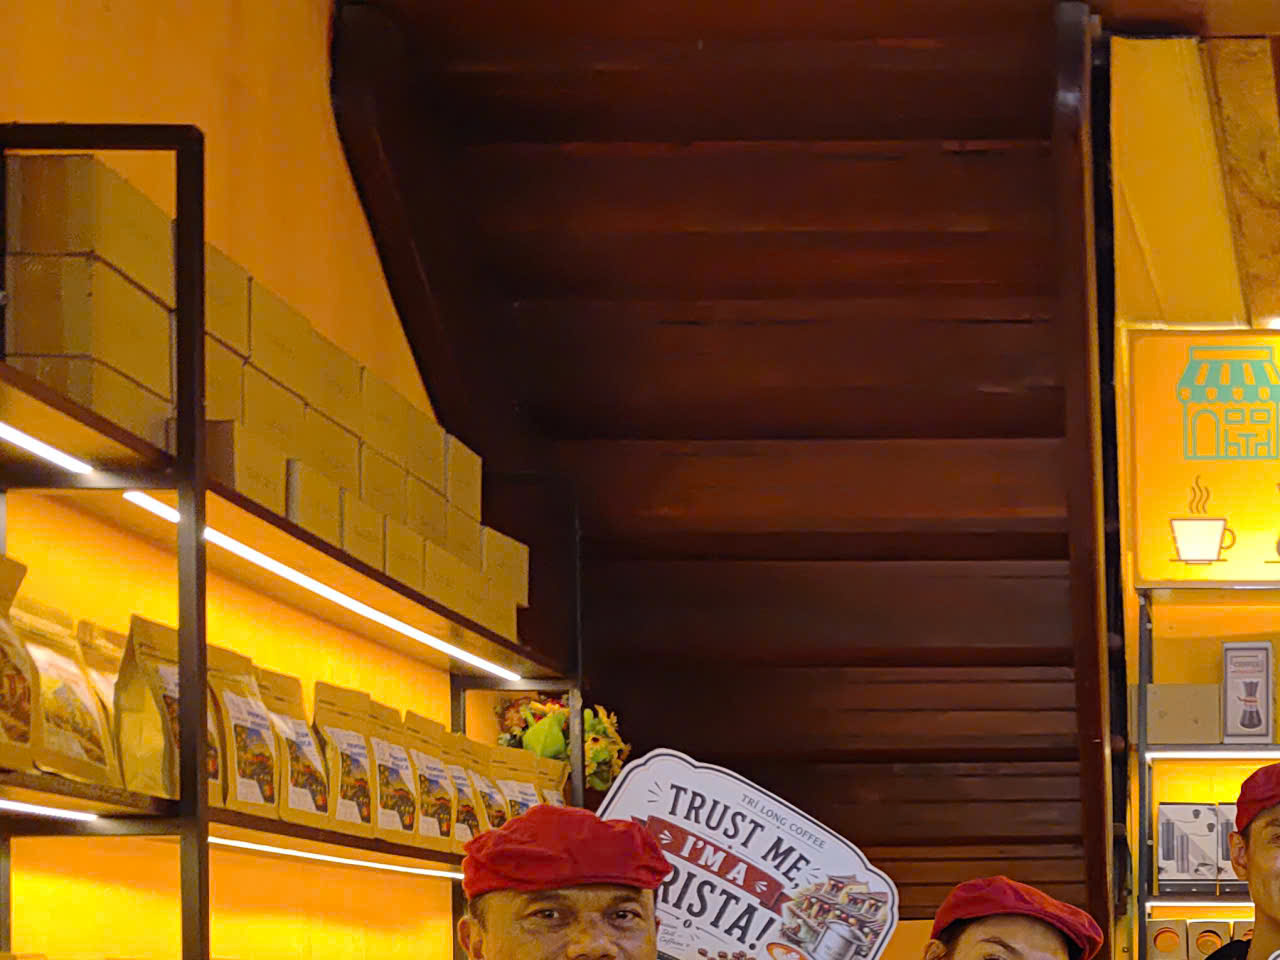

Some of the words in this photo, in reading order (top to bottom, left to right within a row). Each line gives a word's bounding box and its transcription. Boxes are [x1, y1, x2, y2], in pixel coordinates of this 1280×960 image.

[668, 783, 766, 849] TRUST
[761, 835, 811, 889] ME,
[741, 793, 758, 809] TRÍ
[760, 805, 788, 826] LONG
[789, 823, 827, 849] COFFEE
[680, 835, 727, 873] I'M
[726, 861, 749, 886] A
[657, 864, 777, 950] RISTA!
